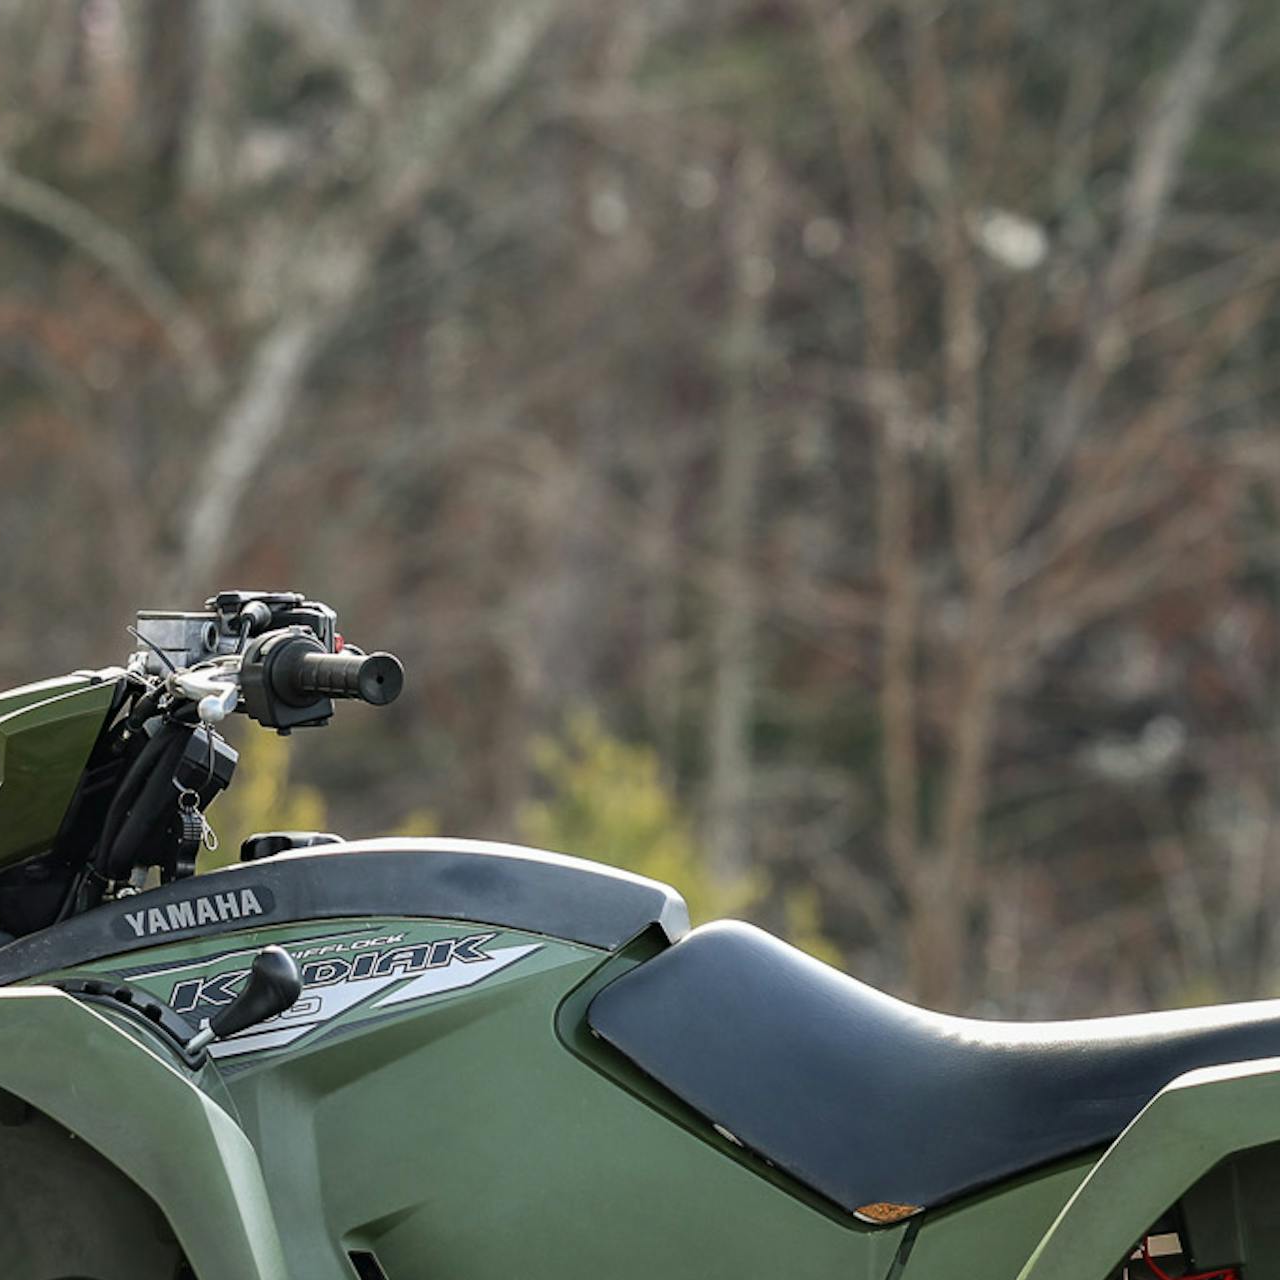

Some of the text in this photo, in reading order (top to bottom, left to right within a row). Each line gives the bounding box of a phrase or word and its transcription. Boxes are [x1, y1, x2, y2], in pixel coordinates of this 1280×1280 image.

[124, 888, 263, 937] YAMAHA
[291, 931, 408, 959] IFFLOCK
[170, 931, 503, 1014] KDIAK
